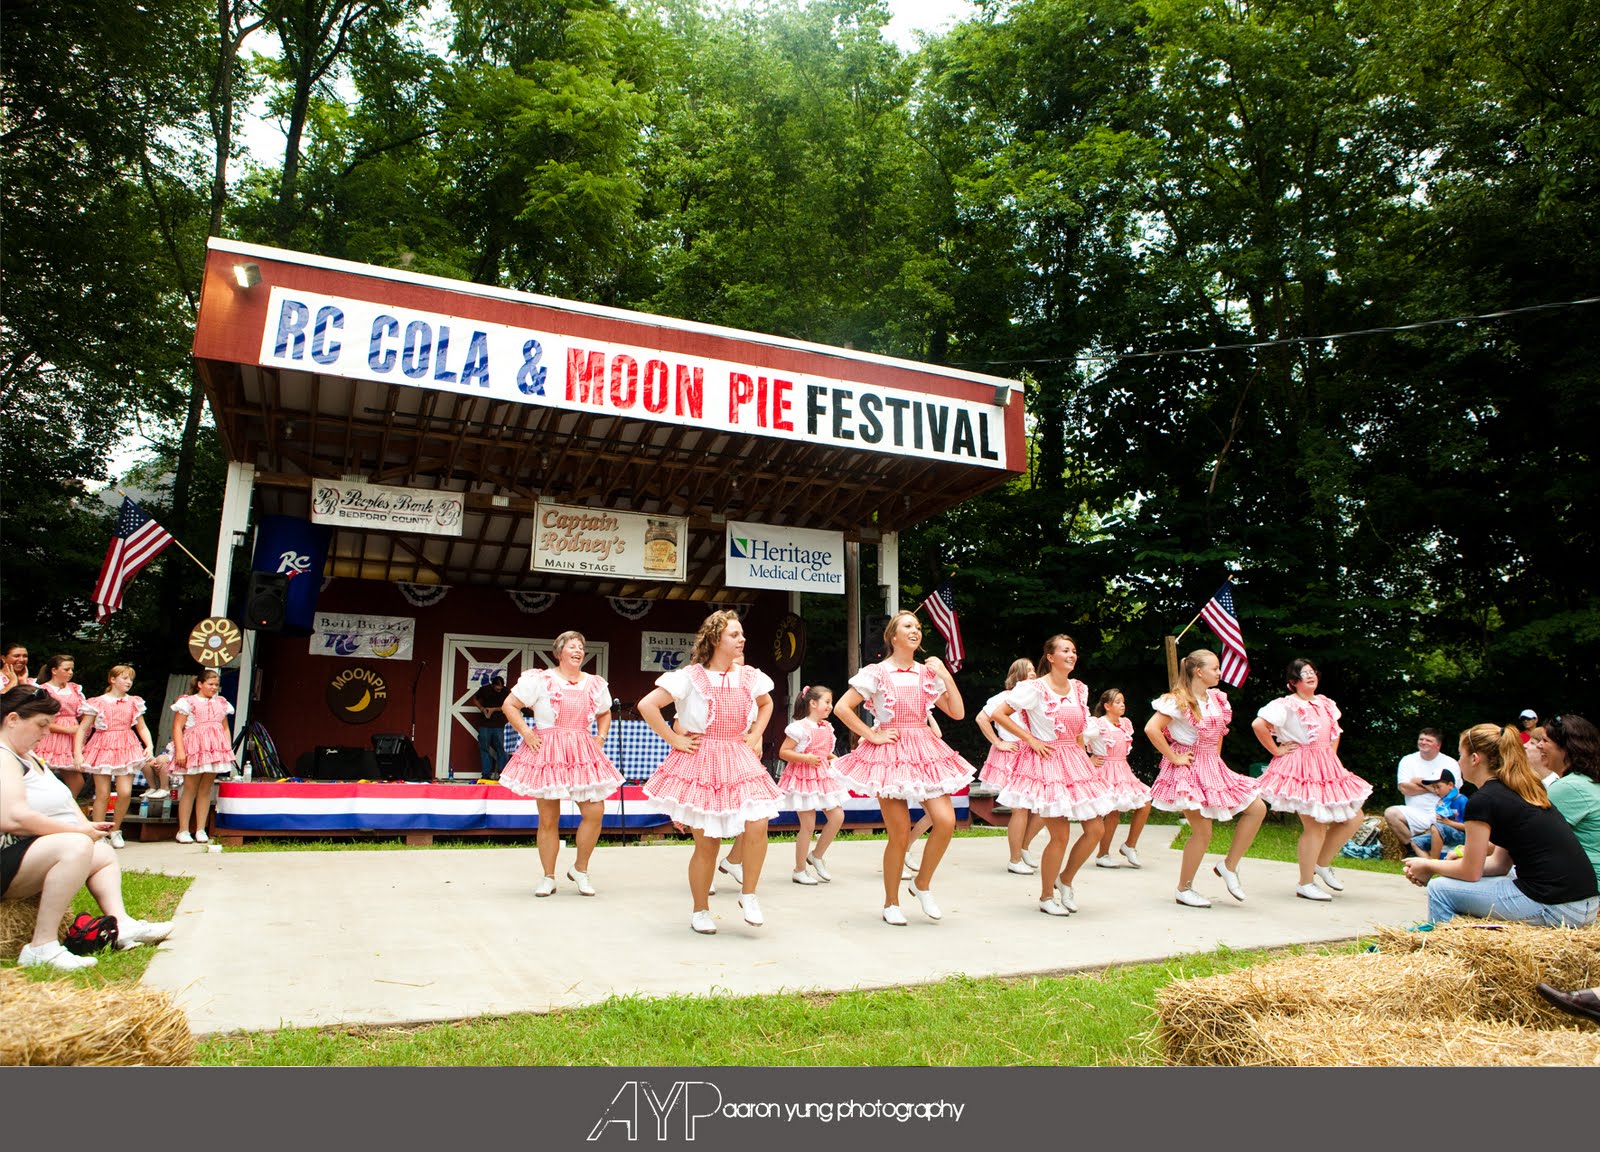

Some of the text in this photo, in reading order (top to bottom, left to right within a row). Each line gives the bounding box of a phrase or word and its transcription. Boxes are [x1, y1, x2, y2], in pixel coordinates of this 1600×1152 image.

[274, 299, 998, 461] RC COLA & MOON PIE FESTIVAL
[340, 489, 434, 514] Peoples Bank
[339, 511, 432, 525] BEDFORD COUNTY
[541, 509, 620, 537] Captain
[539, 531, 626, 561] Rodney's
[750, 539, 832, 571] Heritage
[276, 551, 312, 573] RC
[749, 564, 842, 583] Medical Center
[189, 619, 241, 647] MOON
[649, 637, 674, 645] Bell
[199, 647, 233, 666] PIE
[332, 668, 387, 699] MOONPIE
